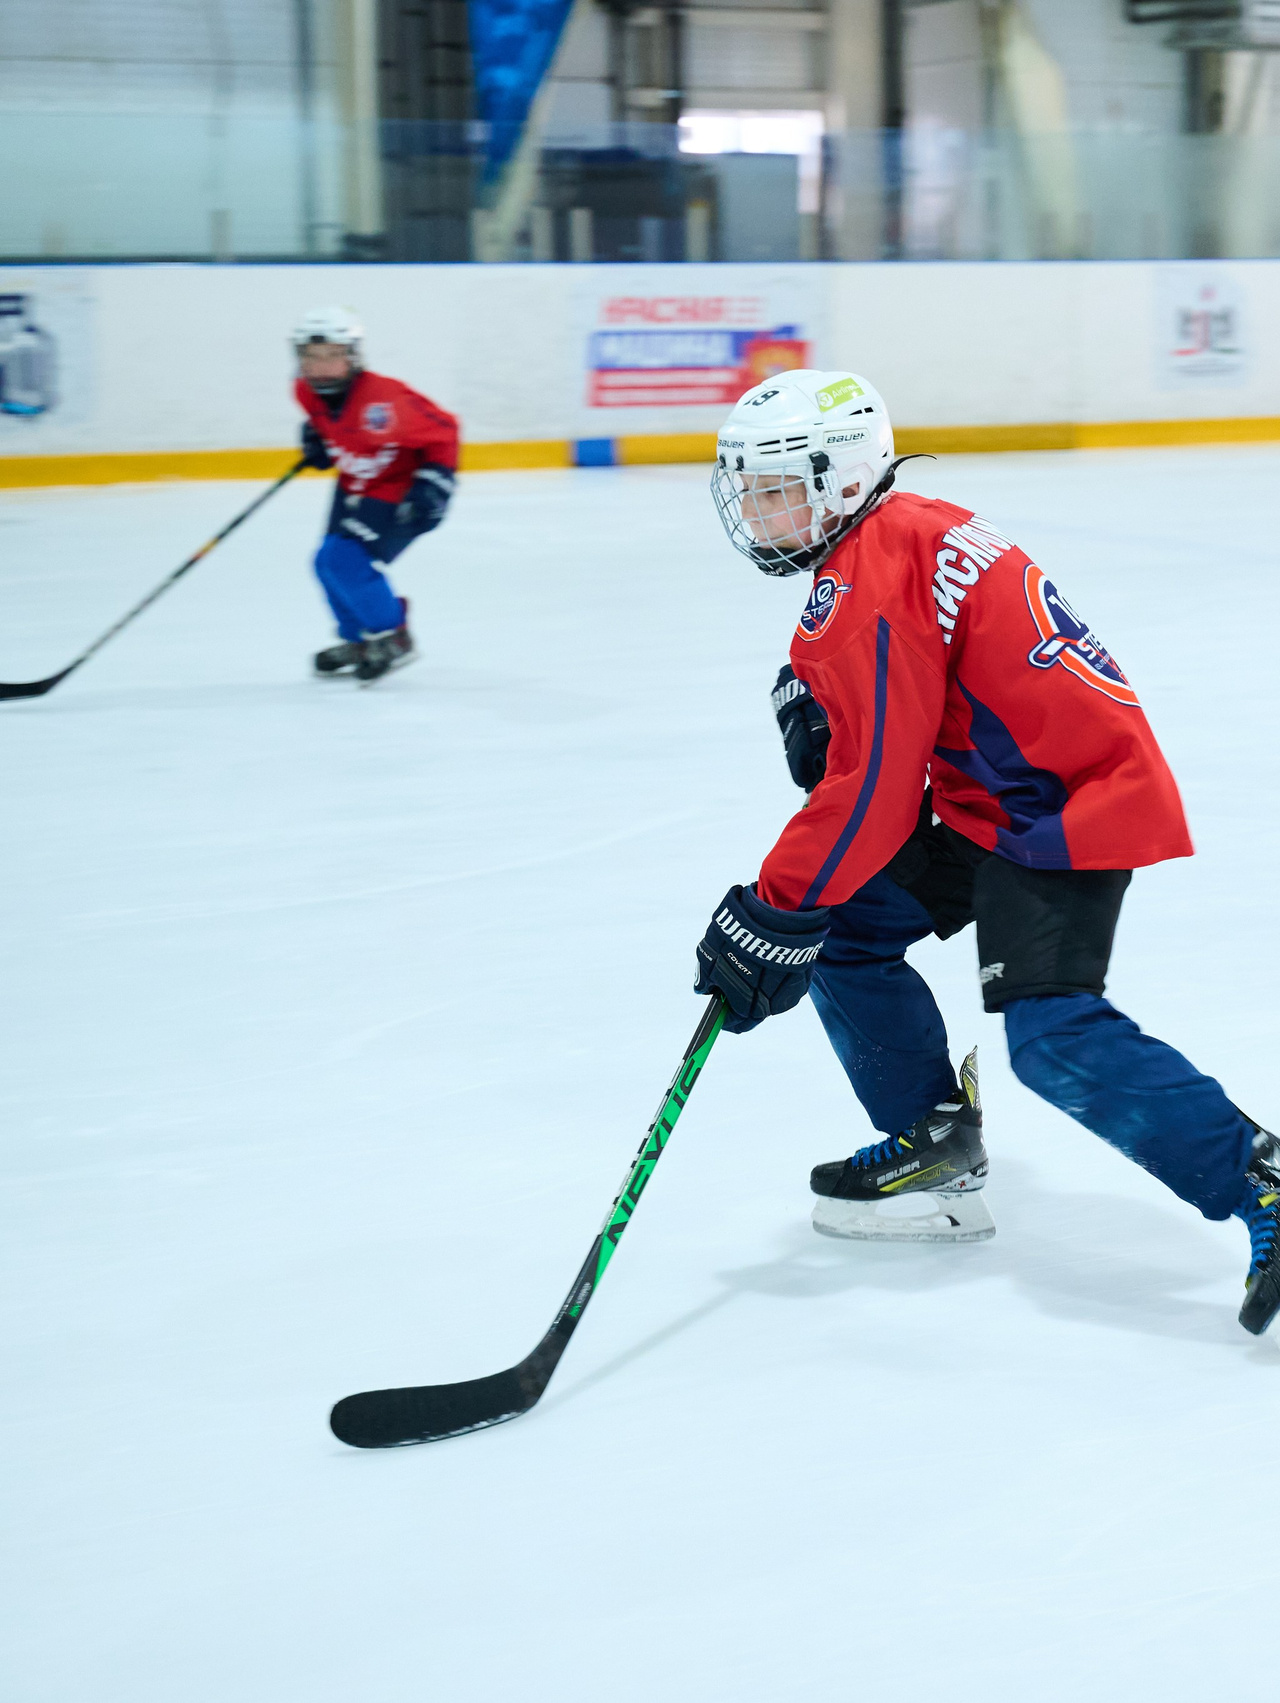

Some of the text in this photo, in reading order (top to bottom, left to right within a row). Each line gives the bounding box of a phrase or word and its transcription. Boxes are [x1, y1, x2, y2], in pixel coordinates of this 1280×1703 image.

[826, 432, 866, 444] BAUER
[714, 907, 826, 966] WARRIOR
[727, 952, 753, 975] COVERT
[605, 1057, 702, 1247] NEXUS
[876, 1160, 921, 1186] BAUER
